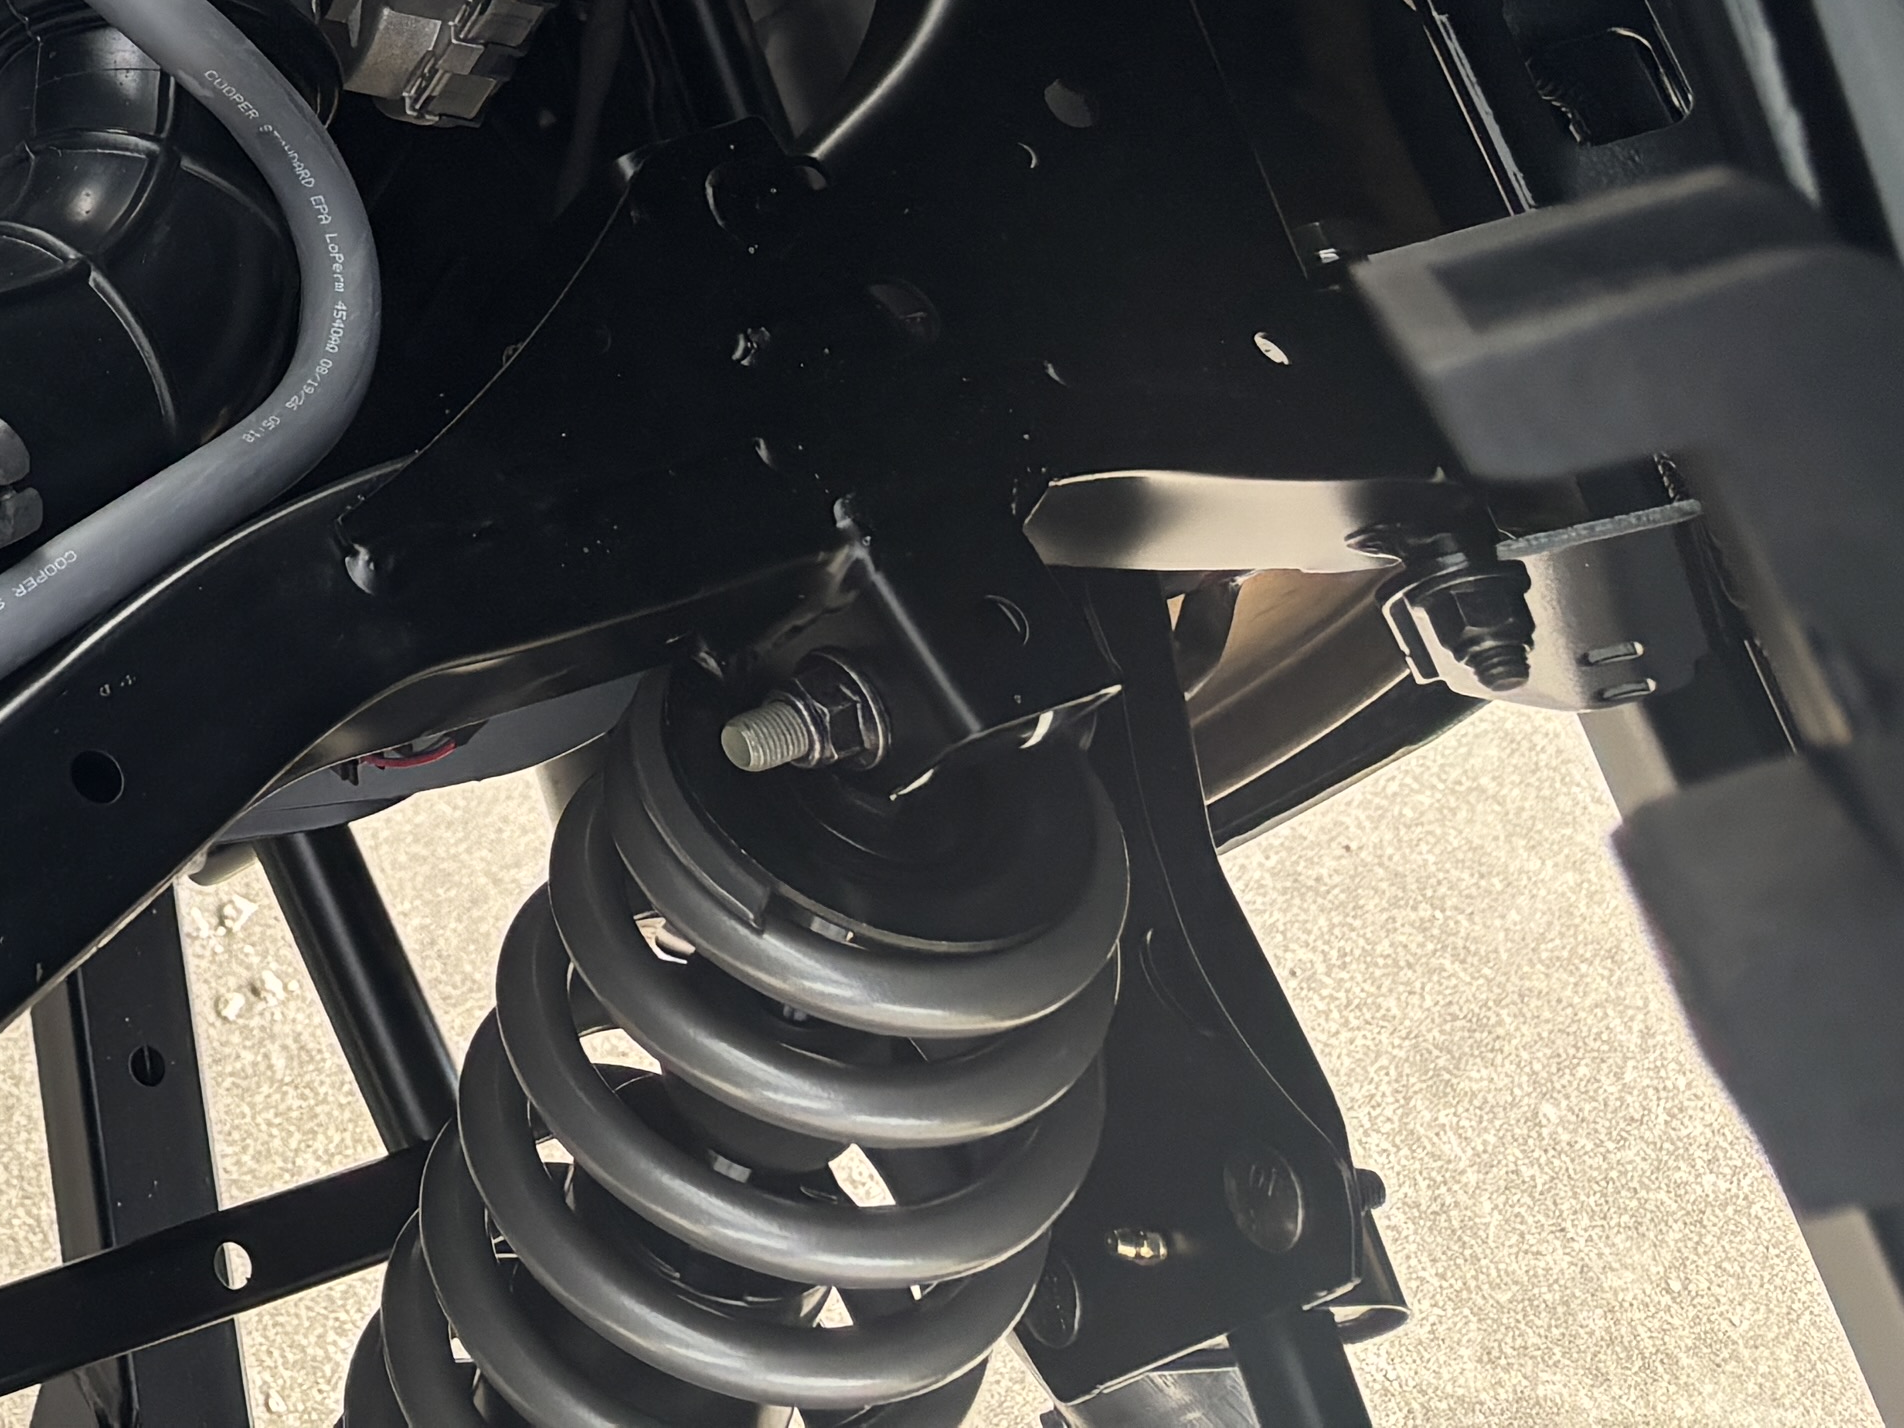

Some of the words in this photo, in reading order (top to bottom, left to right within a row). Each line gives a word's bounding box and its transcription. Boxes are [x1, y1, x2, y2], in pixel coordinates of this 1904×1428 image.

[310, 195, 332, 225] EPA
[324, 232, 345, 293] LoPerm
[12, 549, 78, 598] COOPER
